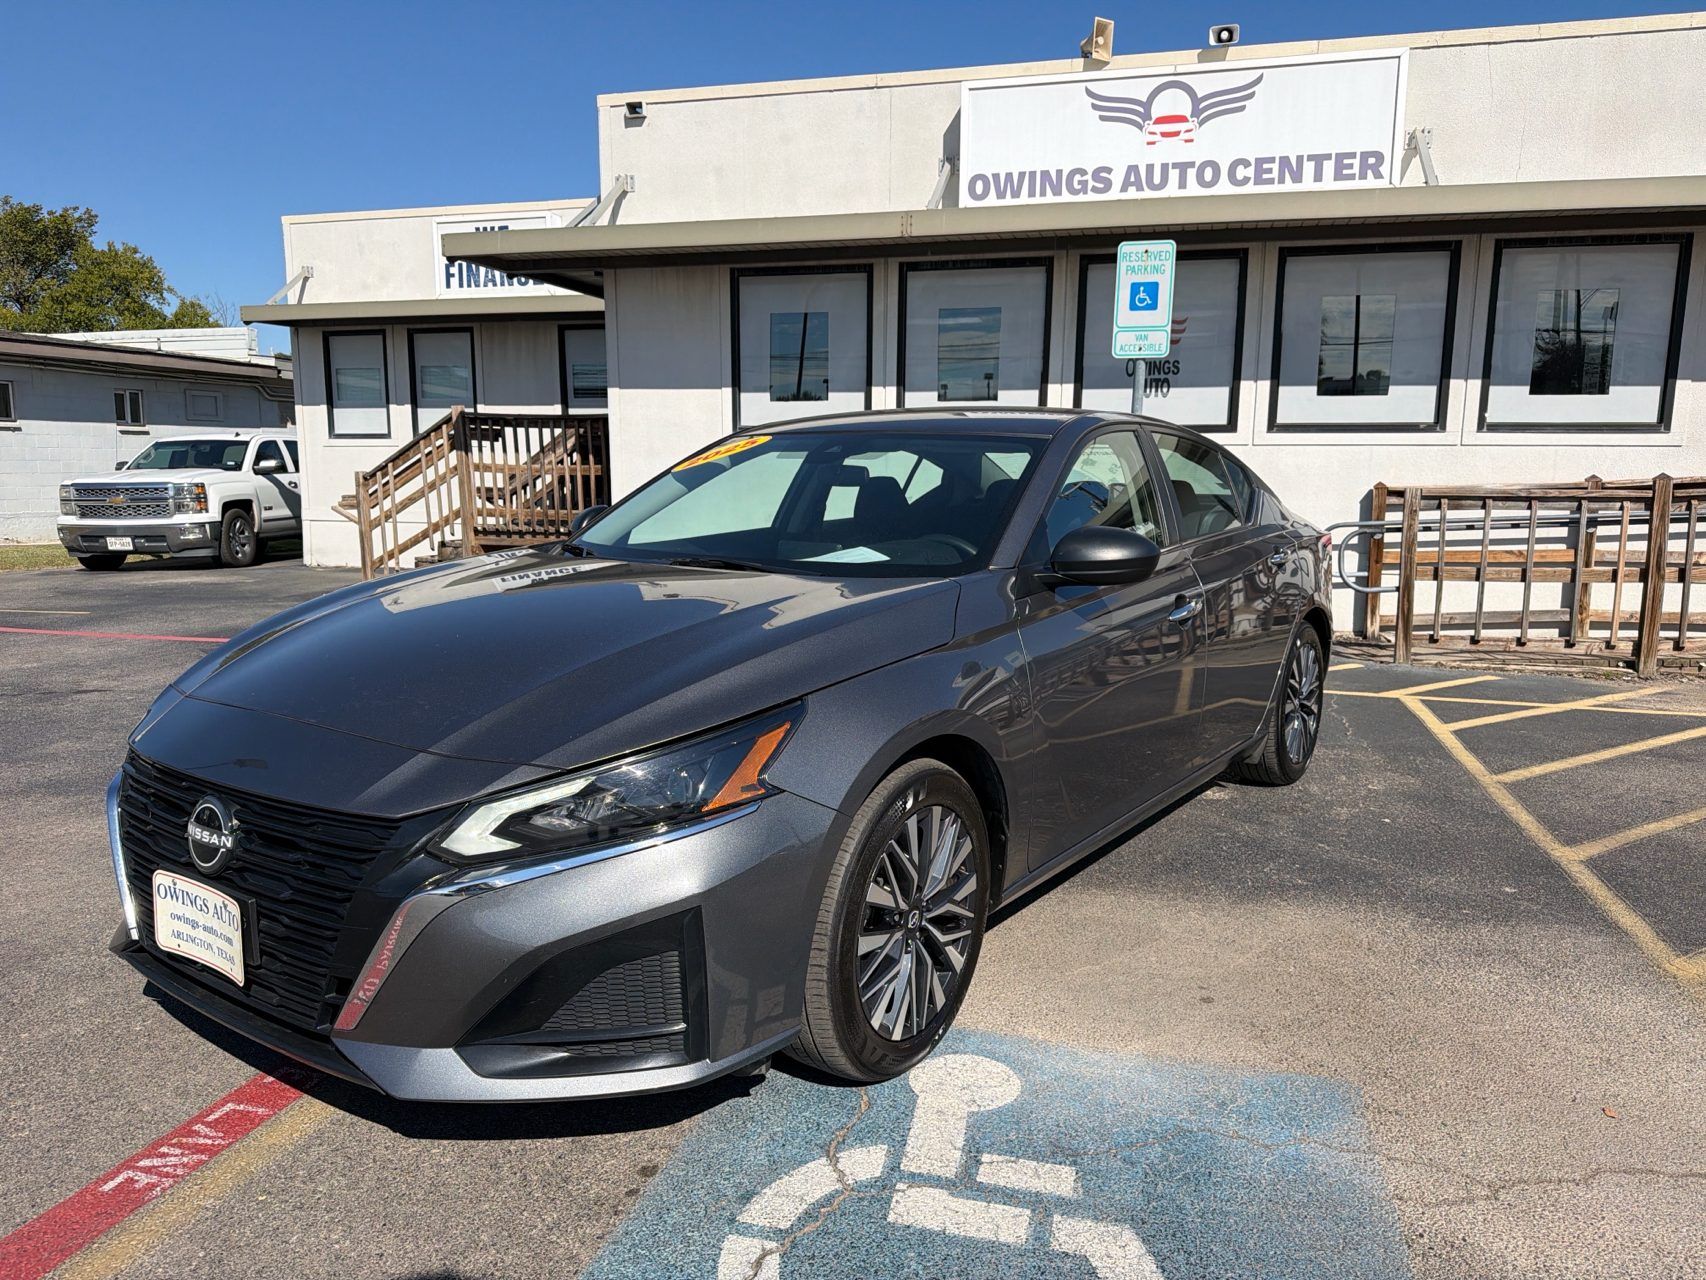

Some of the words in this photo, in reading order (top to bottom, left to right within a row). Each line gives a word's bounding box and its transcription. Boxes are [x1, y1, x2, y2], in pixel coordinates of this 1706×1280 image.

[968, 165, 1114, 203] OWINGS
[1119, 158, 1222, 193] AUTO
[1227, 150, 1386, 188] CENTER
[1121, 249, 1171, 263] RESERVED
[1125, 264, 1167, 276] PARKING
[1134, 333, 1149, 343] VAN
[1143, 378, 1171, 399] UTO
[685, 439, 760, 466] 2025
[188, 822, 232, 848] NISSAN
[156, 882, 210, 915] OWINGS
[211, 902, 239, 933] AUTO
[170, 912, 234, 948] owings-auto.com
[170, 928, 216, 957] ARLINGTON,
[216, 948, 236, 967] TEXAS
